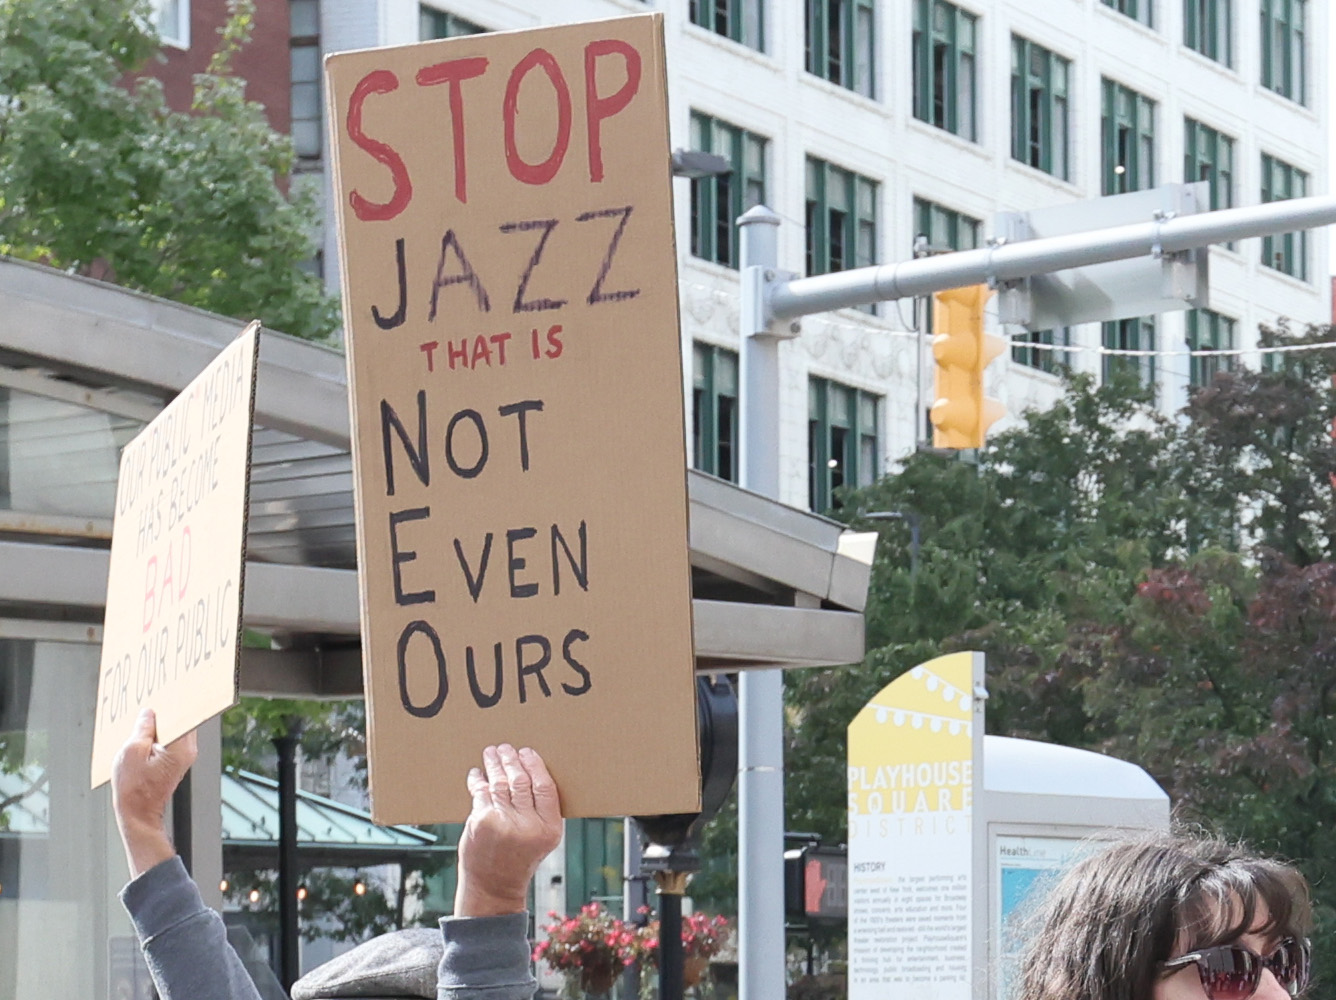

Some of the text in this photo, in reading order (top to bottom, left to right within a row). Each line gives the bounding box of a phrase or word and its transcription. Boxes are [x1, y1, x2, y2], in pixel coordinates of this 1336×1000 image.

[345, 38, 642, 222] STOP
[370, 204, 640, 331] JAZZ
[420, 325, 563, 372] THAT IS
[148, 392, 194, 487] PUBLIC
[201, 345, 244, 440] MEDIA
[380, 390, 544, 496] NOT
[136, 434, 221, 558] HAS BECOME
[142, 525, 191, 633] BAD
[389, 506, 588, 607] EVEN
[100, 578, 232, 728] FOR OUR PUBLIC
[397, 620, 592, 718] OURS
[848, 760, 972, 790] PLAYHOUSE
[848, 787, 972, 816] SQUARE
[854, 861, 886, 873] HISTORY
